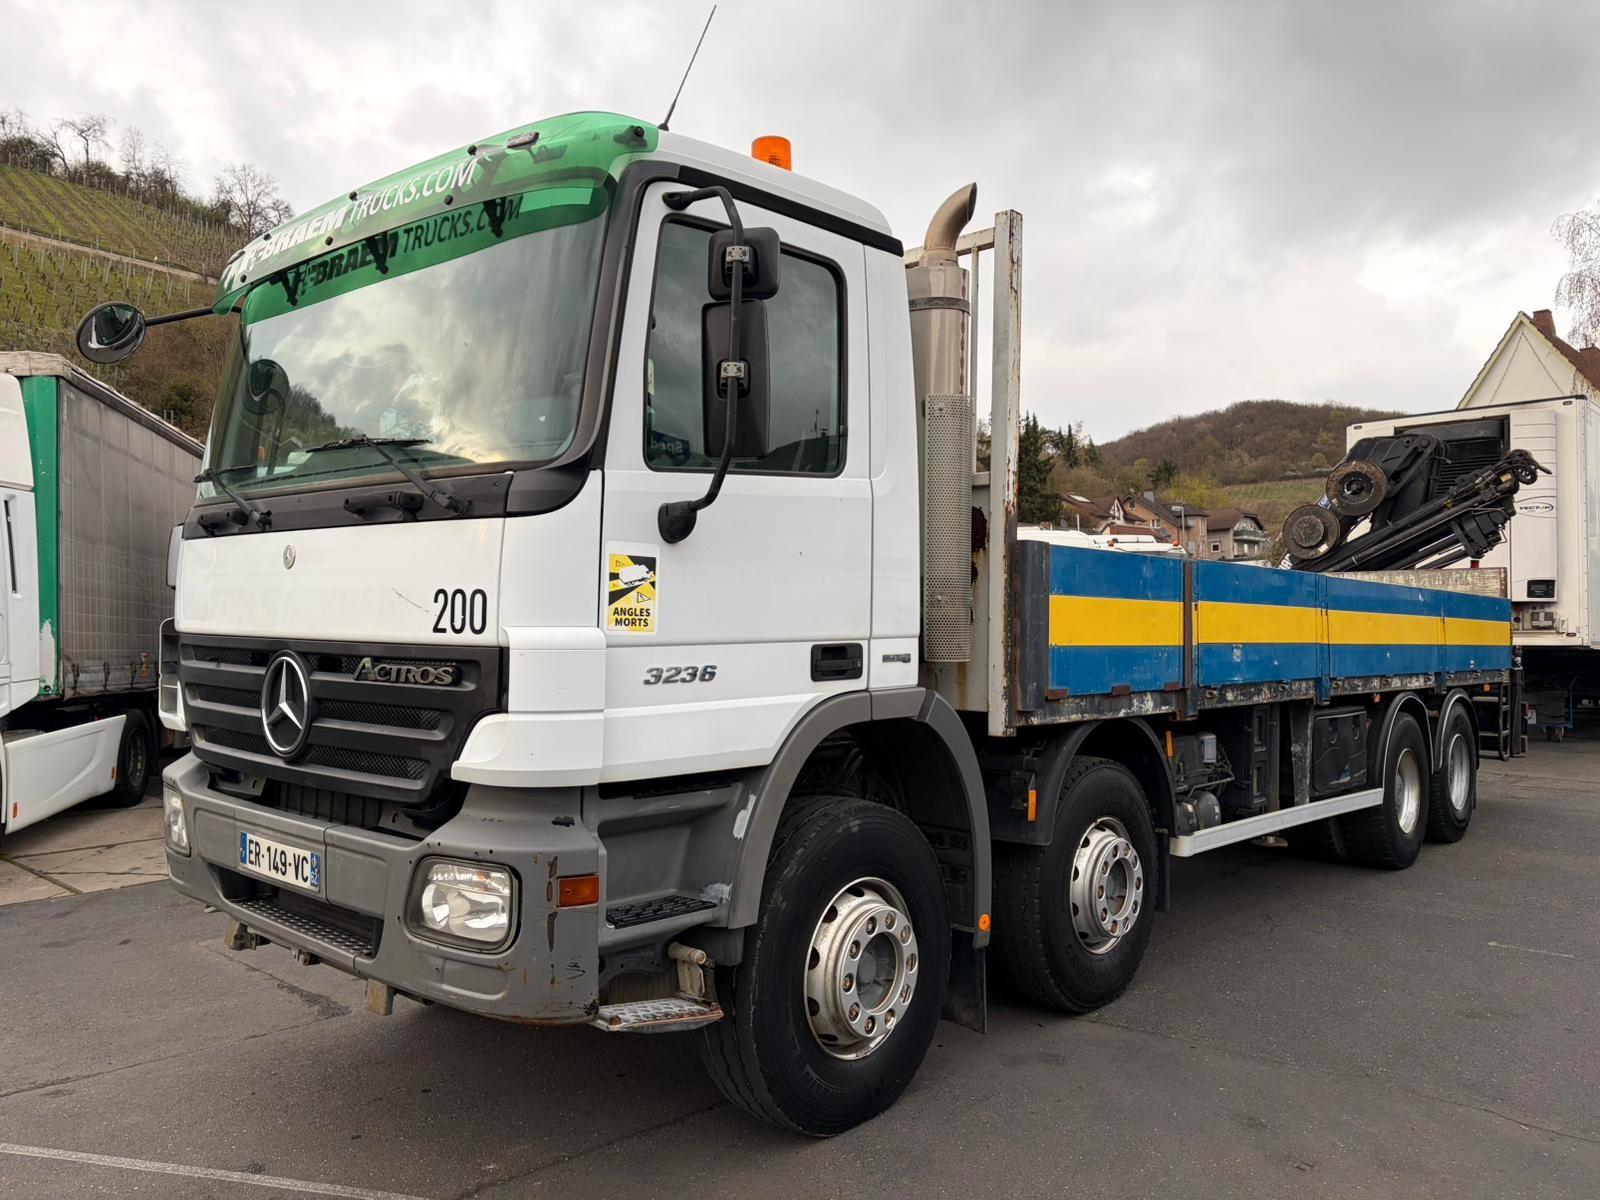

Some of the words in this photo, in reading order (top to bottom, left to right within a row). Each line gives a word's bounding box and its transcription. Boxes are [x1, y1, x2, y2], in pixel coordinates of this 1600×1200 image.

[348, 157, 479, 223] TRUCKS.COM
[402, 194, 524, 253] TRUCKS.CM
[432, 588, 488, 635] 200
[613, 607, 651, 617] ANGLES
[614, 617, 649, 628] MORTS
[643, 665, 718, 686] 3236
